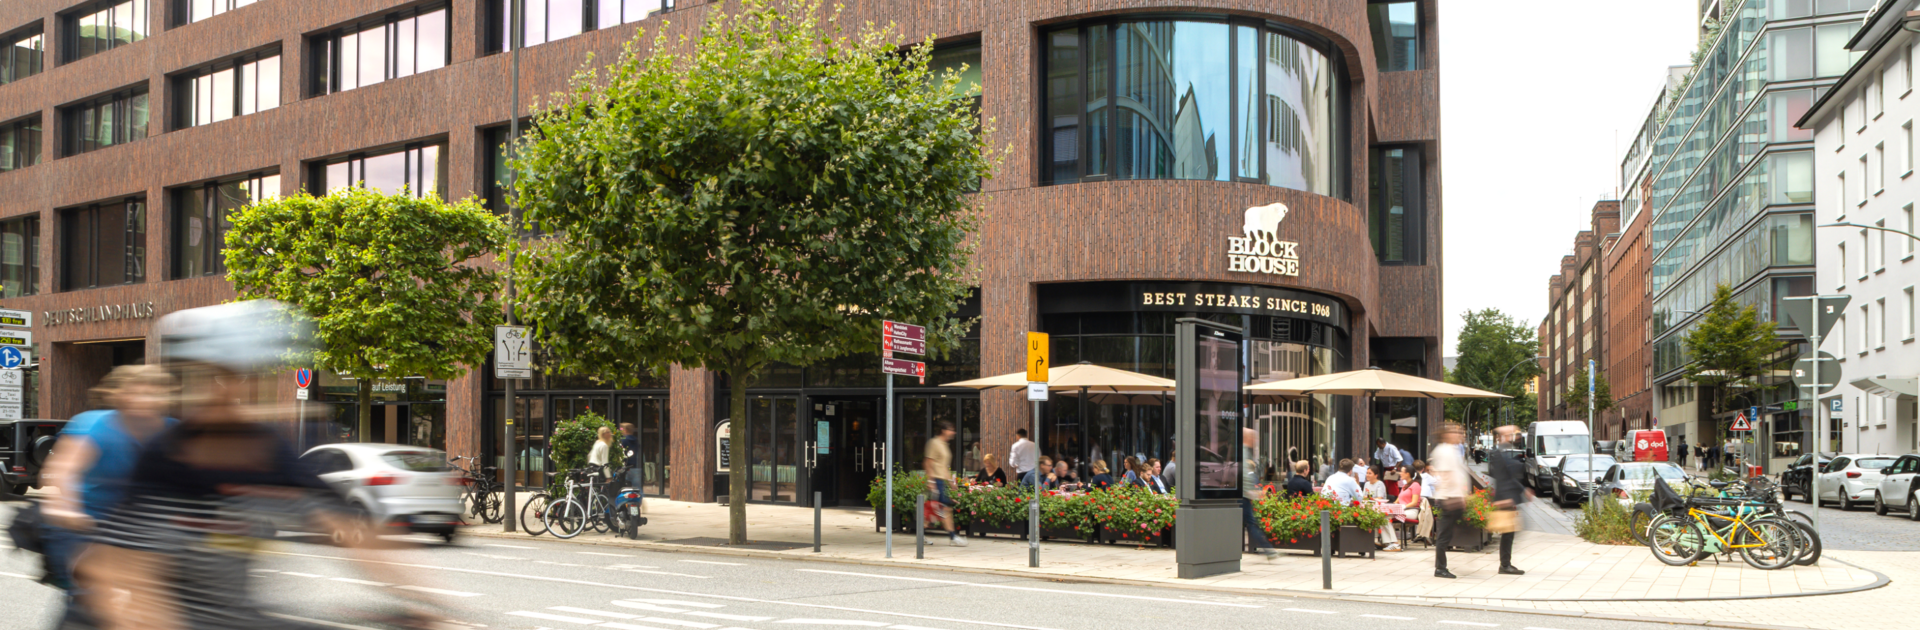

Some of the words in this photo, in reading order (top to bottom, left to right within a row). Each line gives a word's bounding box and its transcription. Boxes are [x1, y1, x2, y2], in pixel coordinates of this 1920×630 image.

[1228, 236, 1299, 259] BLOCK
[1228, 254, 1299, 277] HOUSE
[1143, 292, 1187, 305] BEST
[1195, 293, 1260, 309] STEAKS
[1266, 297, 1307, 313] SINCE
[1311, 302, 1330, 317] 1968
[42, 301, 153, 326] DEUTSCHLANDHAUS
[1032, 340, 1038, 350] U
[372, 382, 381, 391] auf
[382, 382, 406, 394] Leistung
[1221, 410, 1236, 420] BOSS
[1650, 440, 1664, 448] dpd
